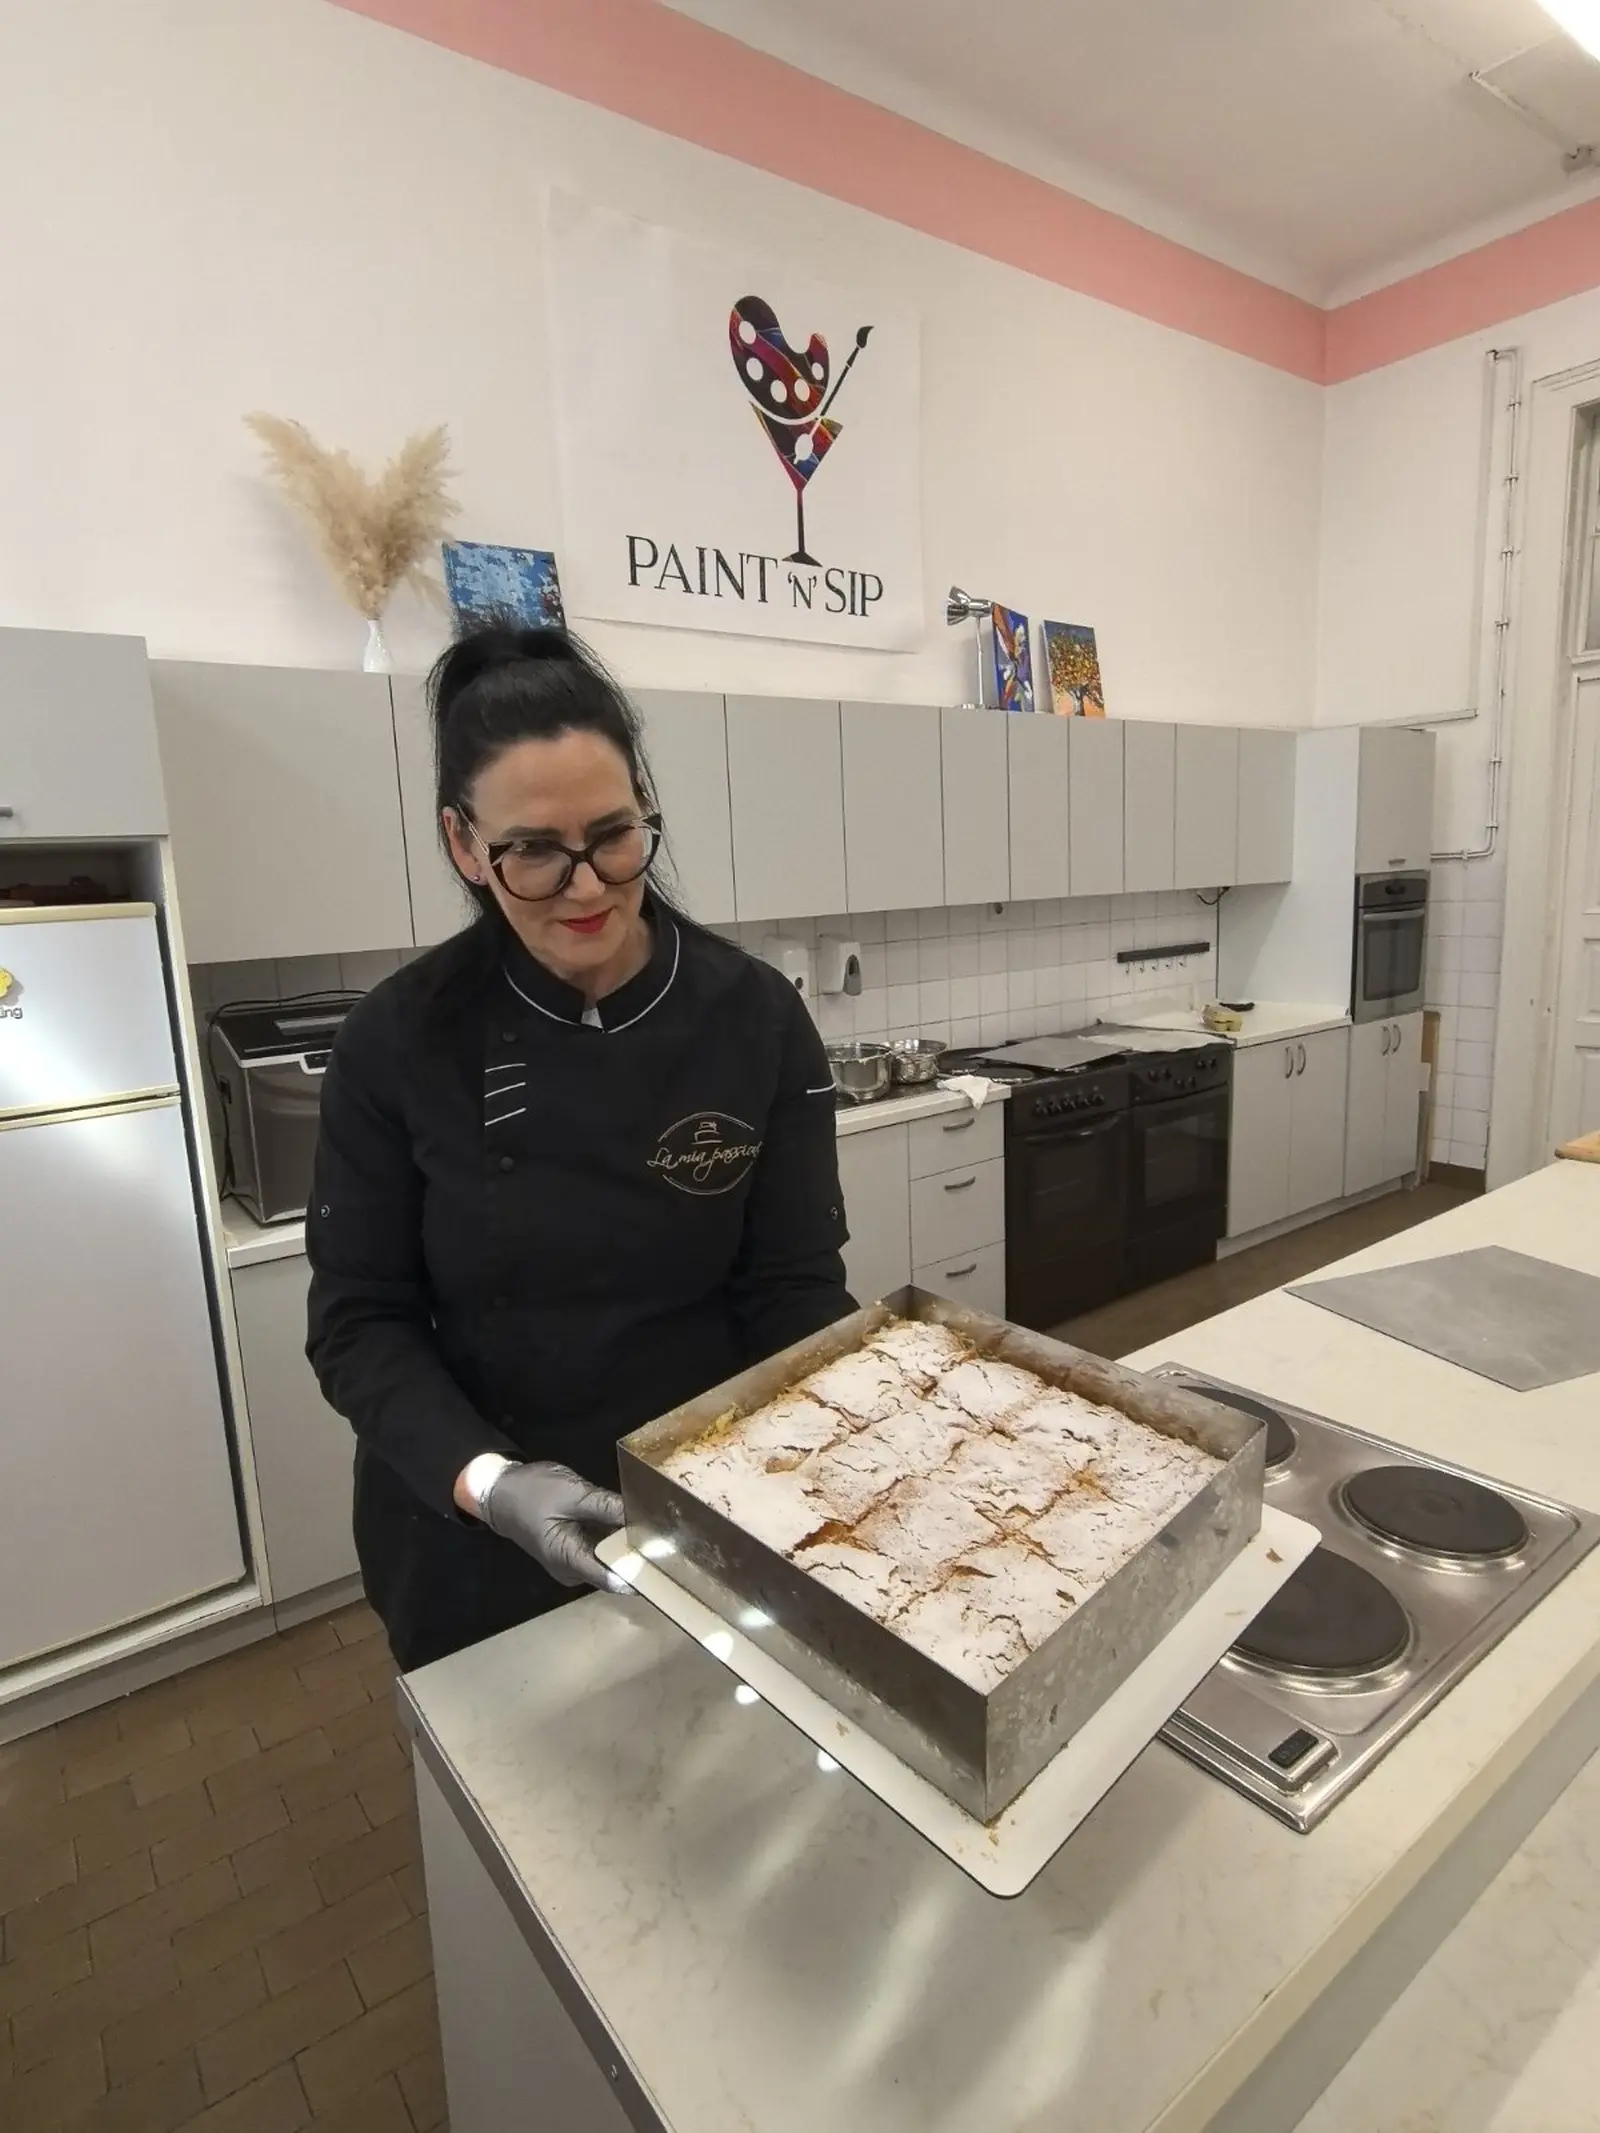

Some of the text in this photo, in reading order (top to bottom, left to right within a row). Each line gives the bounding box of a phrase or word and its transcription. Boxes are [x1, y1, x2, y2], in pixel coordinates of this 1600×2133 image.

[626, 535, 778, 603] PAINT
[825, 568, 884, 617] SIP
[646, 1147, 679, 1170] La
